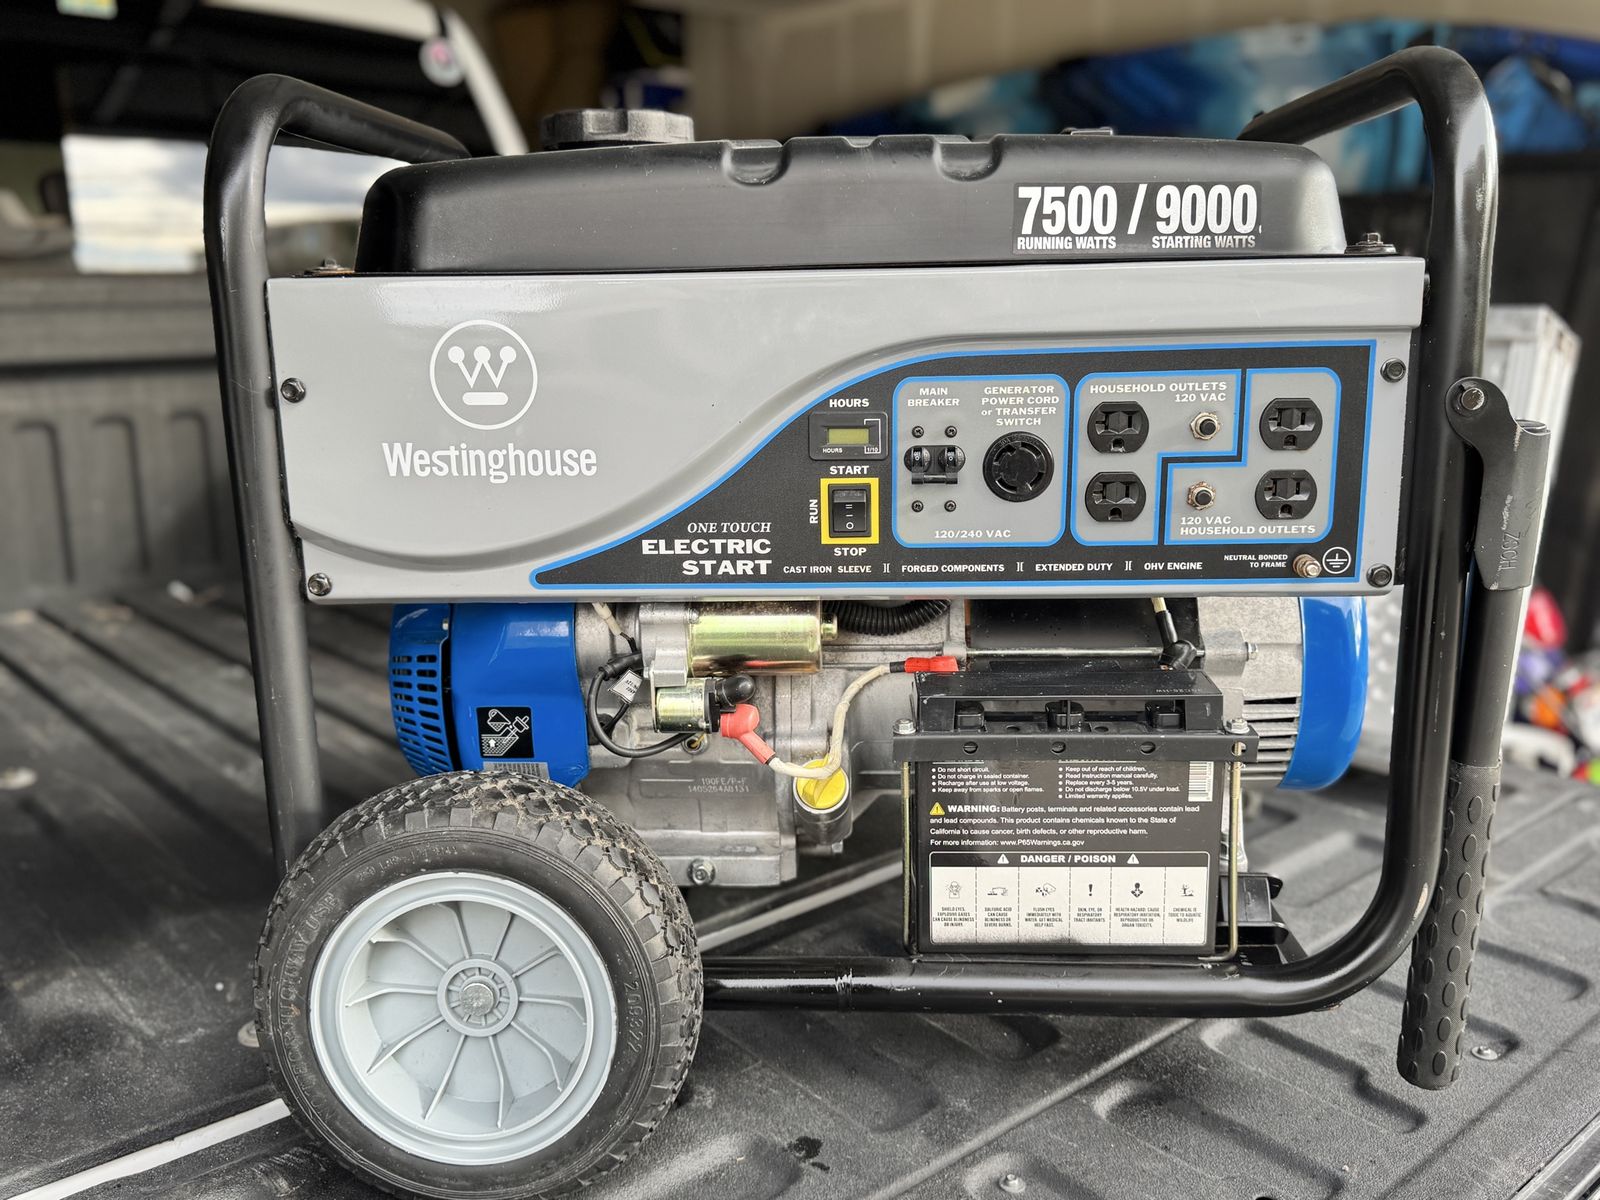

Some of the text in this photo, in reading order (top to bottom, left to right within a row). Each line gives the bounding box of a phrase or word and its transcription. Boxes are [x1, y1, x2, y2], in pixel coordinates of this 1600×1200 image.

[1018, 184, 1257, 235] 7500 / 9000
[1017, 236, 1116, 249] RUNNING WATTS
[1152, 235, 1255, 248] STARTING WATTS
[920, 387, 948, 396] MAIN
[984, 386, 1054, 394] GENERATOR
[1090, 382, 1227, 393] HOUSEHOLD OUTLETS
[982, 396, 1059, 405] POWER CORD
[1175, 393, 1226, 402] 120 VAC
[829, 399, 869, 408] HOURS
[907, 398, 960, 407] BREAKER
[981, 407, 1056, 416] or TRANSFER
[996, 418, 1041, 426] SWITCH
[382, 443, 597, 483] Westinghouse
[830, 466, 869, 474] START
[809, 500, 818, 524] RUN
[1206, 516, 1231, 524] VAC
[687, 522, 771, 533] ONE TOUCH
[1180, 525, 1315, 535] HOUSEHOLD OUTLETS
[934, 530, 1011, 539] 120/240 VAC
[642, 539, 771, 555] ELECTRIC
[834, 548, 866, 556] STOP
[682, 560, 772, 575] START
[837, 565, 871, 573] SLEEVE
[902, 564, 1004, 573] FORGED COMPONENTS
[1035, 563, 1085, 571] EXTENDED
[1167, 562, 1203, 570] ENGINE
[1020, 855, 1116, 863] DANGER / POISON
